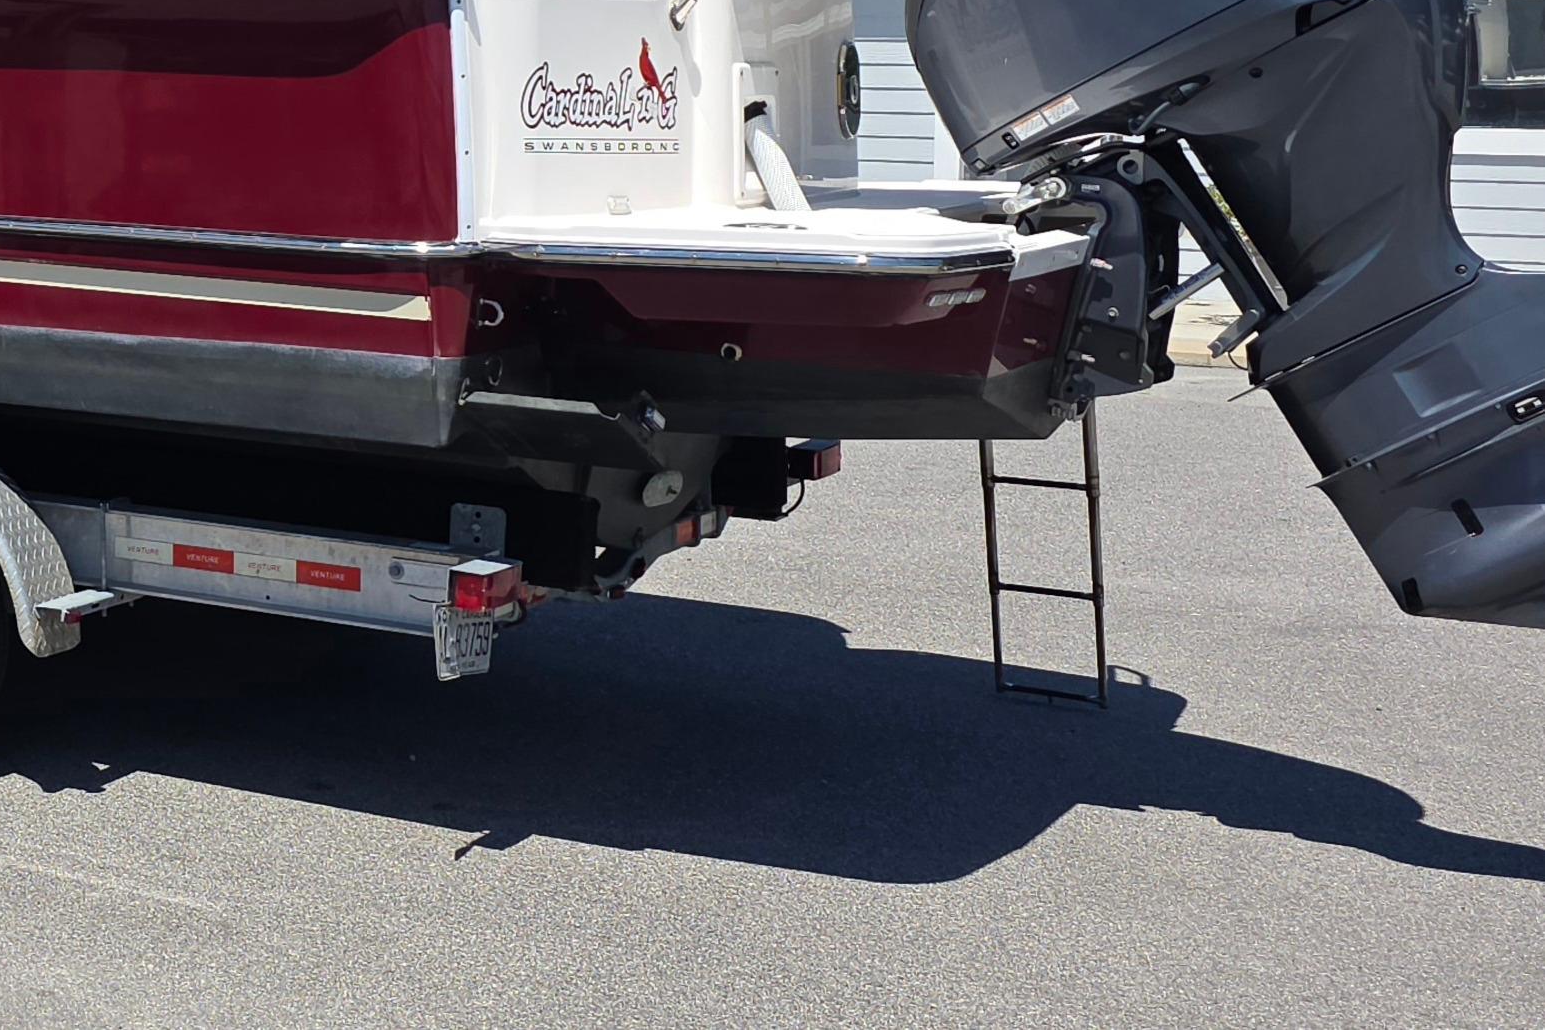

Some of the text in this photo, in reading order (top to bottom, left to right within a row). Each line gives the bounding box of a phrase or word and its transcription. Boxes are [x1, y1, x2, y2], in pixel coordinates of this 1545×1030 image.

[126, 544, 346, 582] VENTURE VENTURE VENTURE VENTURE
